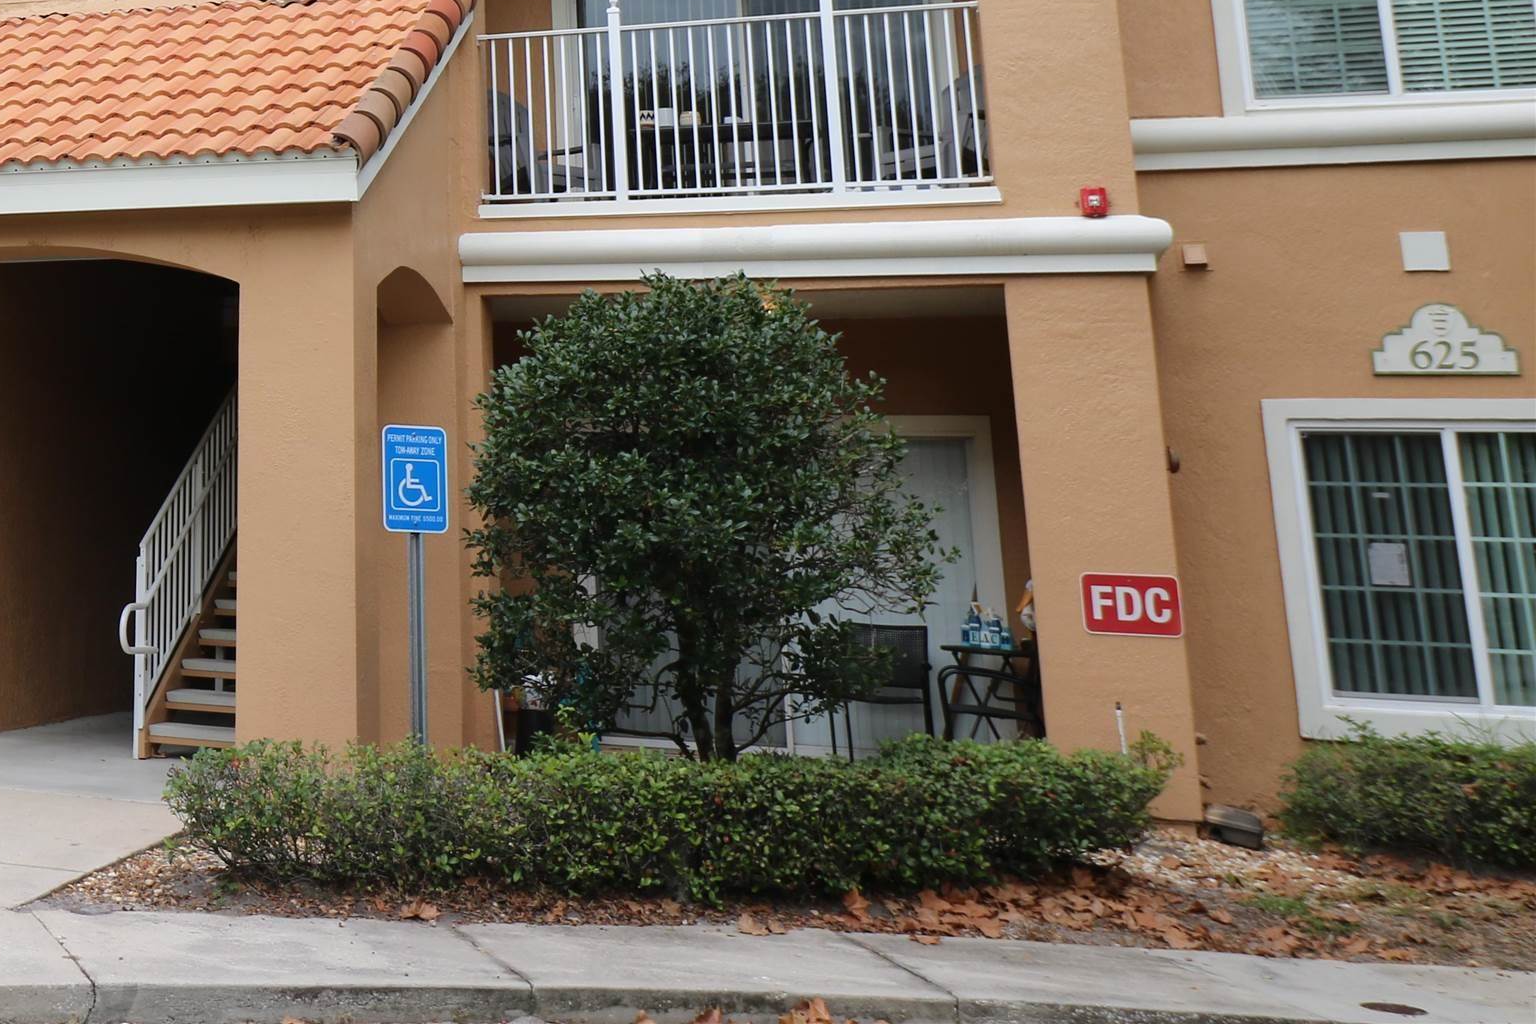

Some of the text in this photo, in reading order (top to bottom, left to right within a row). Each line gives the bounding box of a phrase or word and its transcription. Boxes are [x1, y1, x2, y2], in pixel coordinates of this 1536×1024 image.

[1410, 340, 1479, 370] 625
[387, 433, 442, 444] PERMIT PARKING ONLY
[420, 447, 436, 456] ZONE
[1090, 584, 1173, 624] FDC
